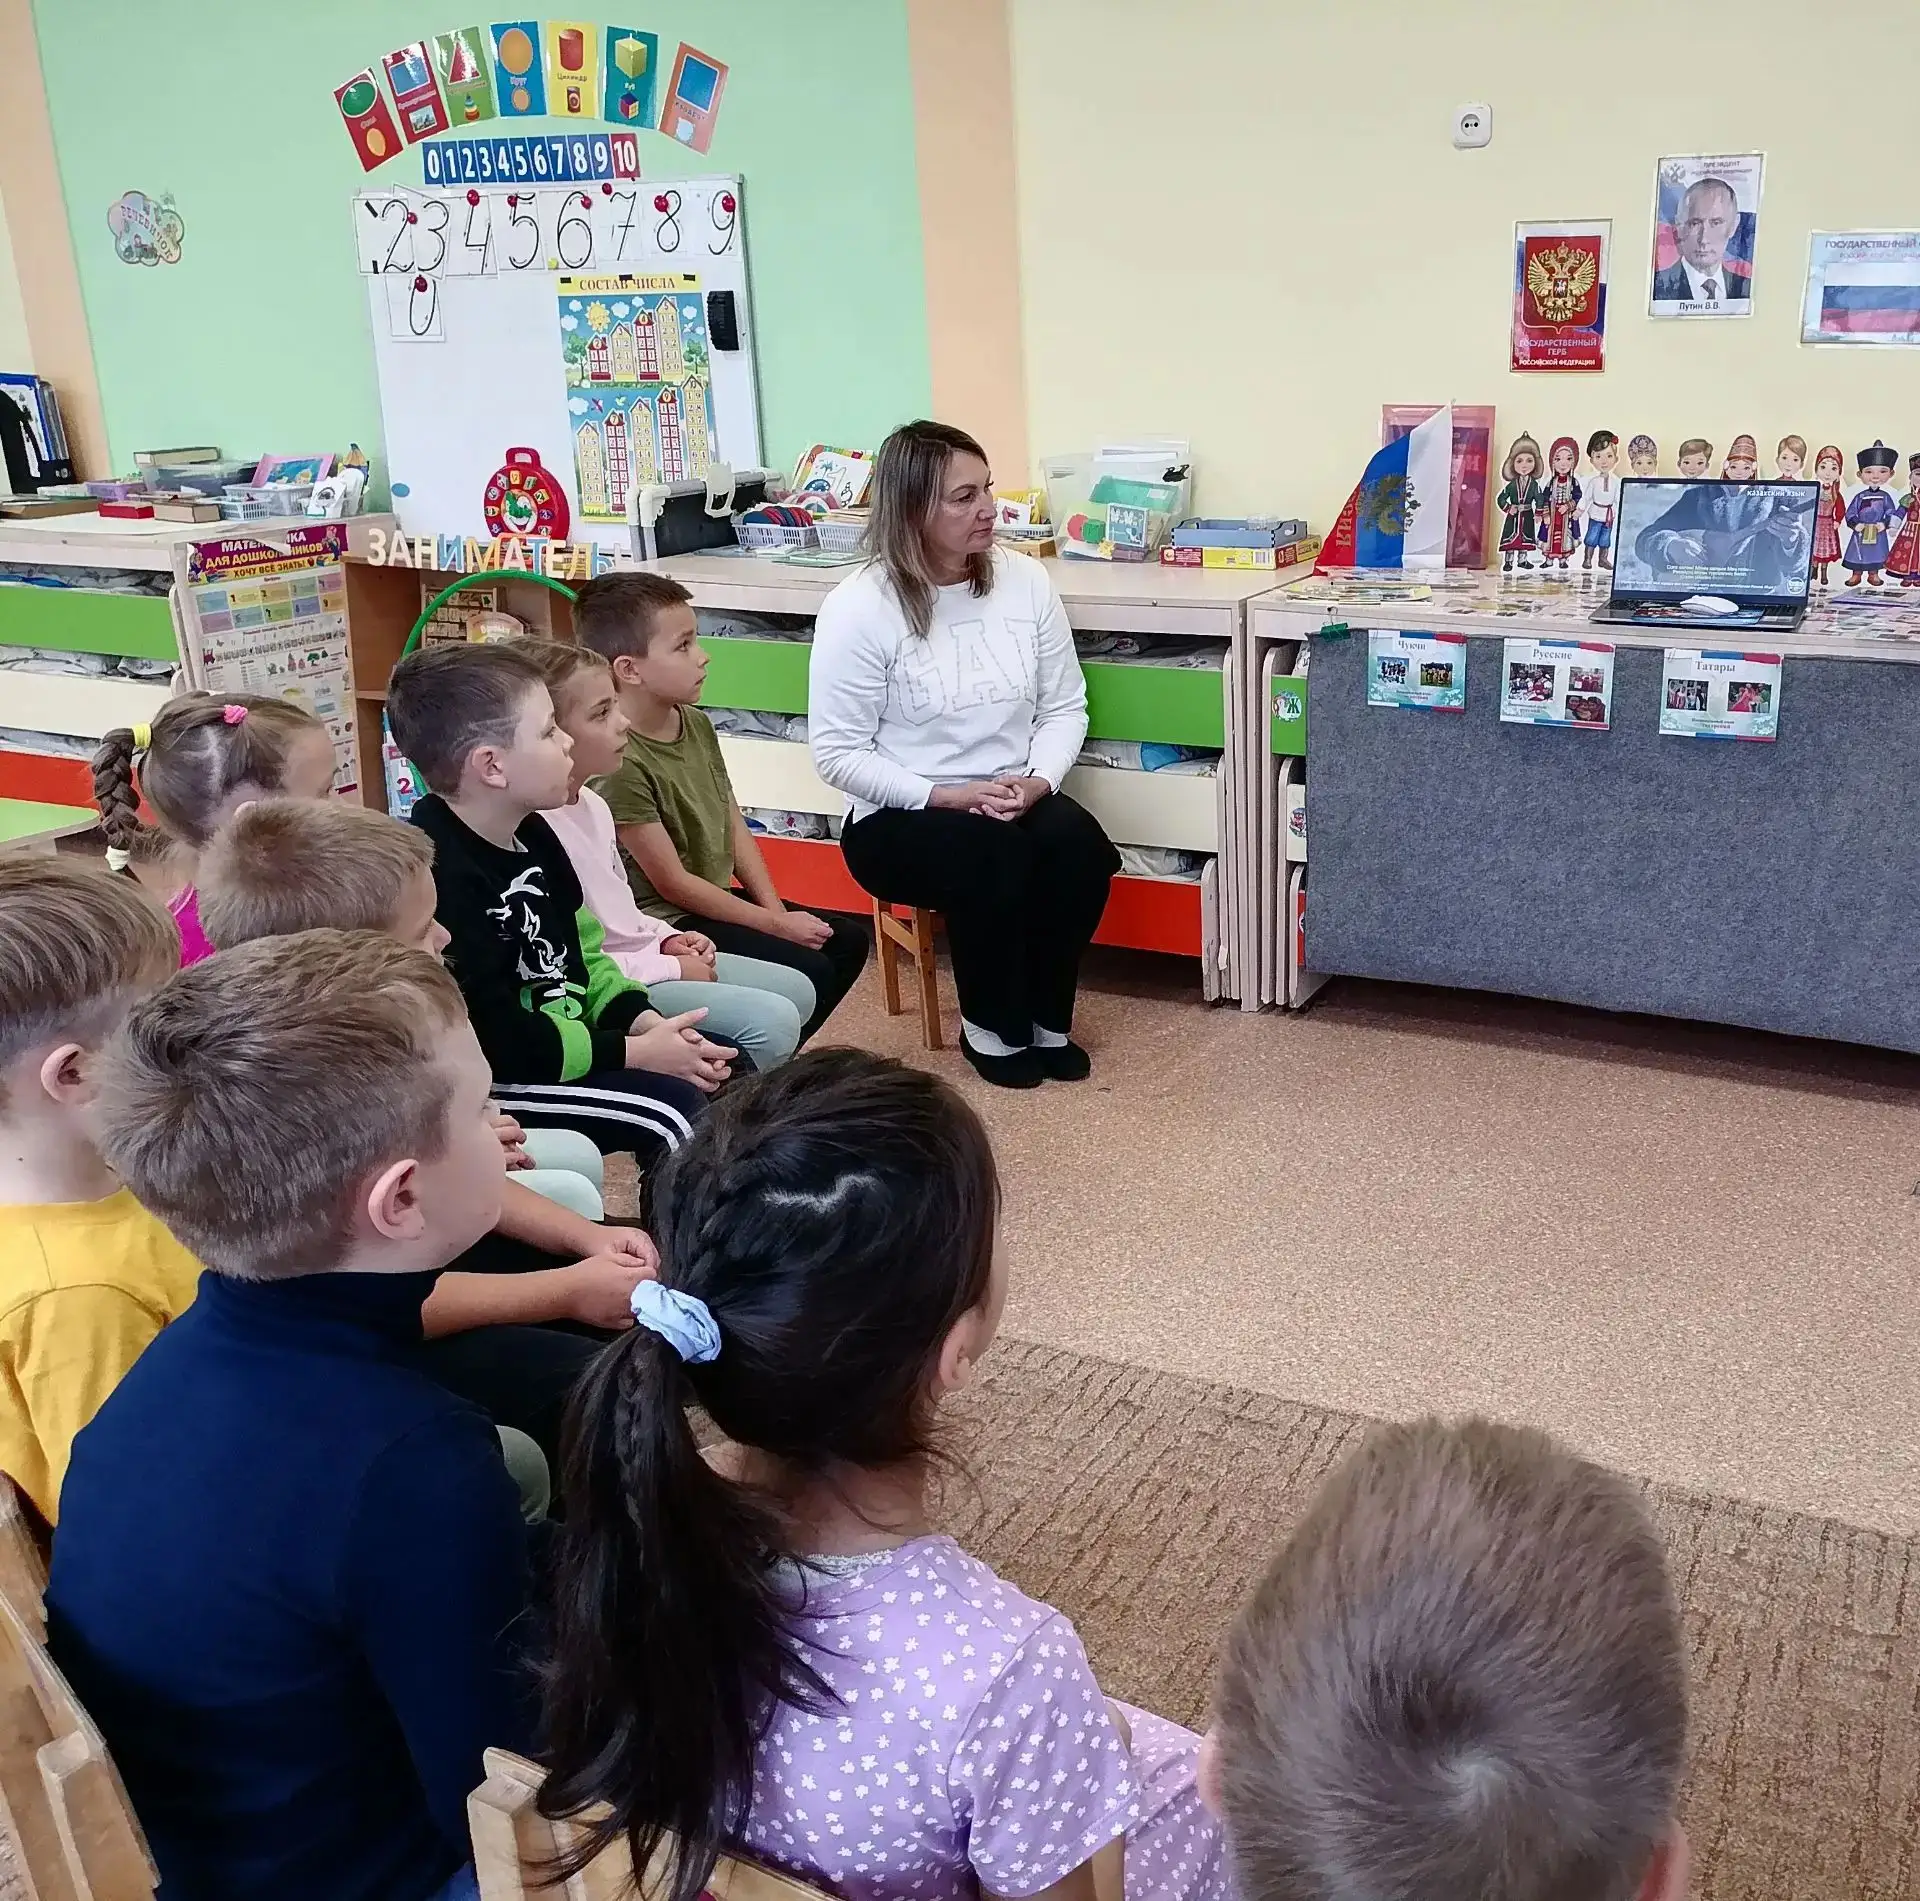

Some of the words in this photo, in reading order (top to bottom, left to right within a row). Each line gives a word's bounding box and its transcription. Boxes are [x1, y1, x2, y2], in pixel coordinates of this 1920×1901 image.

[427, 149, 440, 179] 0
[445, 148, 457, 178] 1
[462, 148, 475, 178] 2
[479, 147, 492, 177] 3
[498, 146, 510, 176] 4
[514, 145, 527, 176] 5
[534, 144, 547, 175] 6
[552, 144, 563, 174] 7
[573, 142, 588, 174] 8
[594, 142, 608, 173] 9
[614, 140, 636, 173] 10
[381, 199, 415, 273] 2
[418, 200, 450, 271] 3
[465, 203, 491, 275] 4
[509, 192, 540, 269] 5
[557, 190, 593, 269] 6
[610, 190, 637, 261] 7
[656, 190, 682, 252] 8
[708, 189, 735, 256] 9
[1825, 238, 1917, 249] ГОСУДАРСТВЕННЫЙ
[579, 279, 628, 291] СОСТАВ
[632, 277, 676, 290] ЧИСЛА
[409, 279, 437, 336] 0
[1679, 302, 1703, 311] Путин
[1704, 301, 1721, 311] В.В.
[1519, 338, 1597, 348] ГОСУДАРСТВЕННЫЙ
[1547, 348, 1567, 356] ГЕРБ
[1519, 358, 1558, 366] РОССИЙСКОЙ
[205, 556, 231, 569] ДЛЯ
[234, 568, 257, 578] ХОЧУ
[277, 560, 306, 571] ЗНАТЬ!
[1398, 640, 1426, 651] Чукчи
[1532, 648, 1573, 660] Русские
[1695, 660, 1736, 674] Татары
[1286, 697, 1300, 714] Ж
[396, 777, 413, 794] 2
